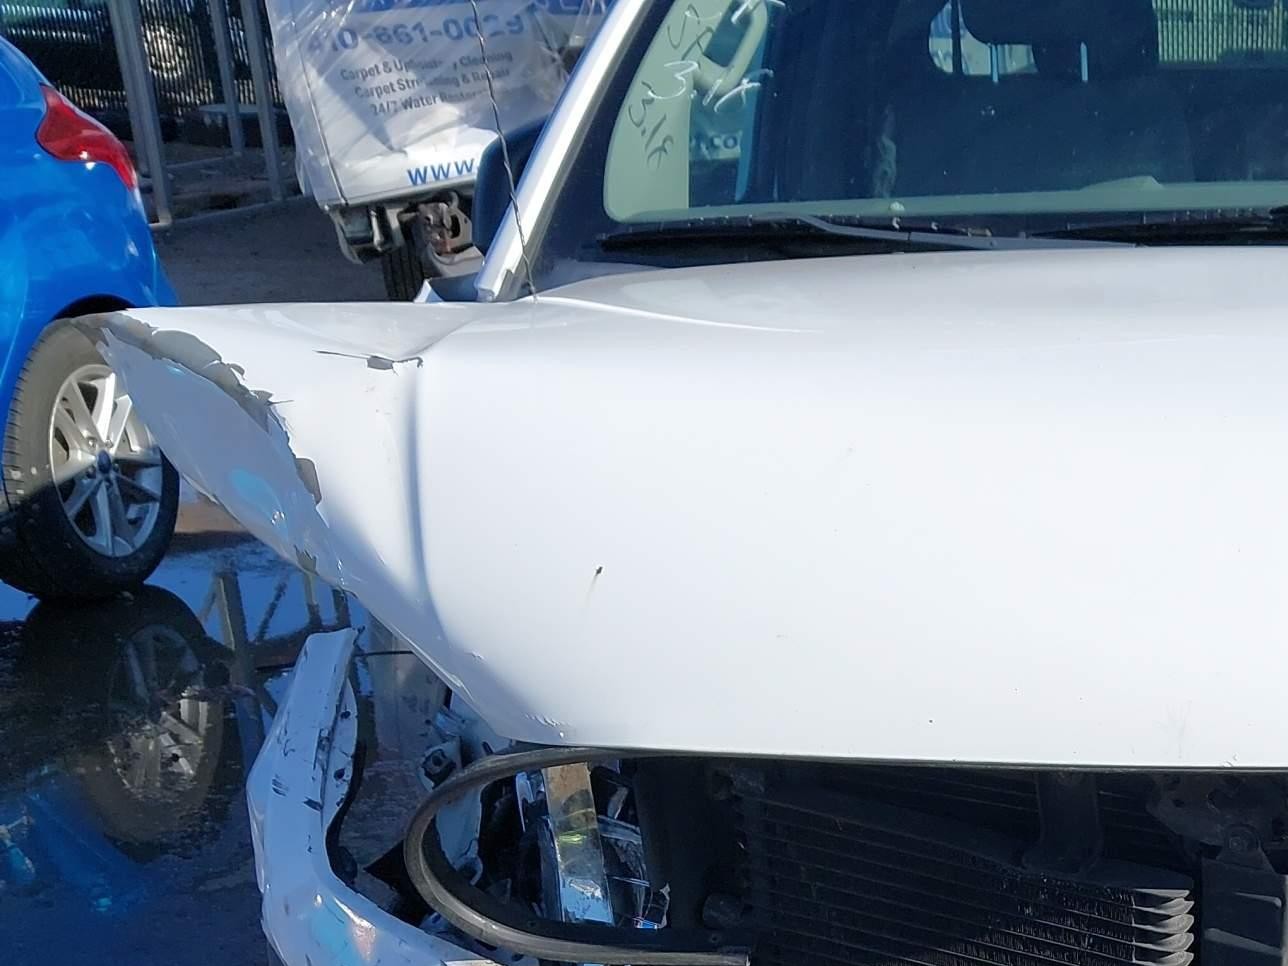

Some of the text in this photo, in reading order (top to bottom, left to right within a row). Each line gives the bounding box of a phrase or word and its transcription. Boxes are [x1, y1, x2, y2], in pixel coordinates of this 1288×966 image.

[340, 63, 380, 81] Carpet
[383, 61, 393, 74] &
[354, 79, 396, 99] Carpet
[401, 94, 438, 111] Water
